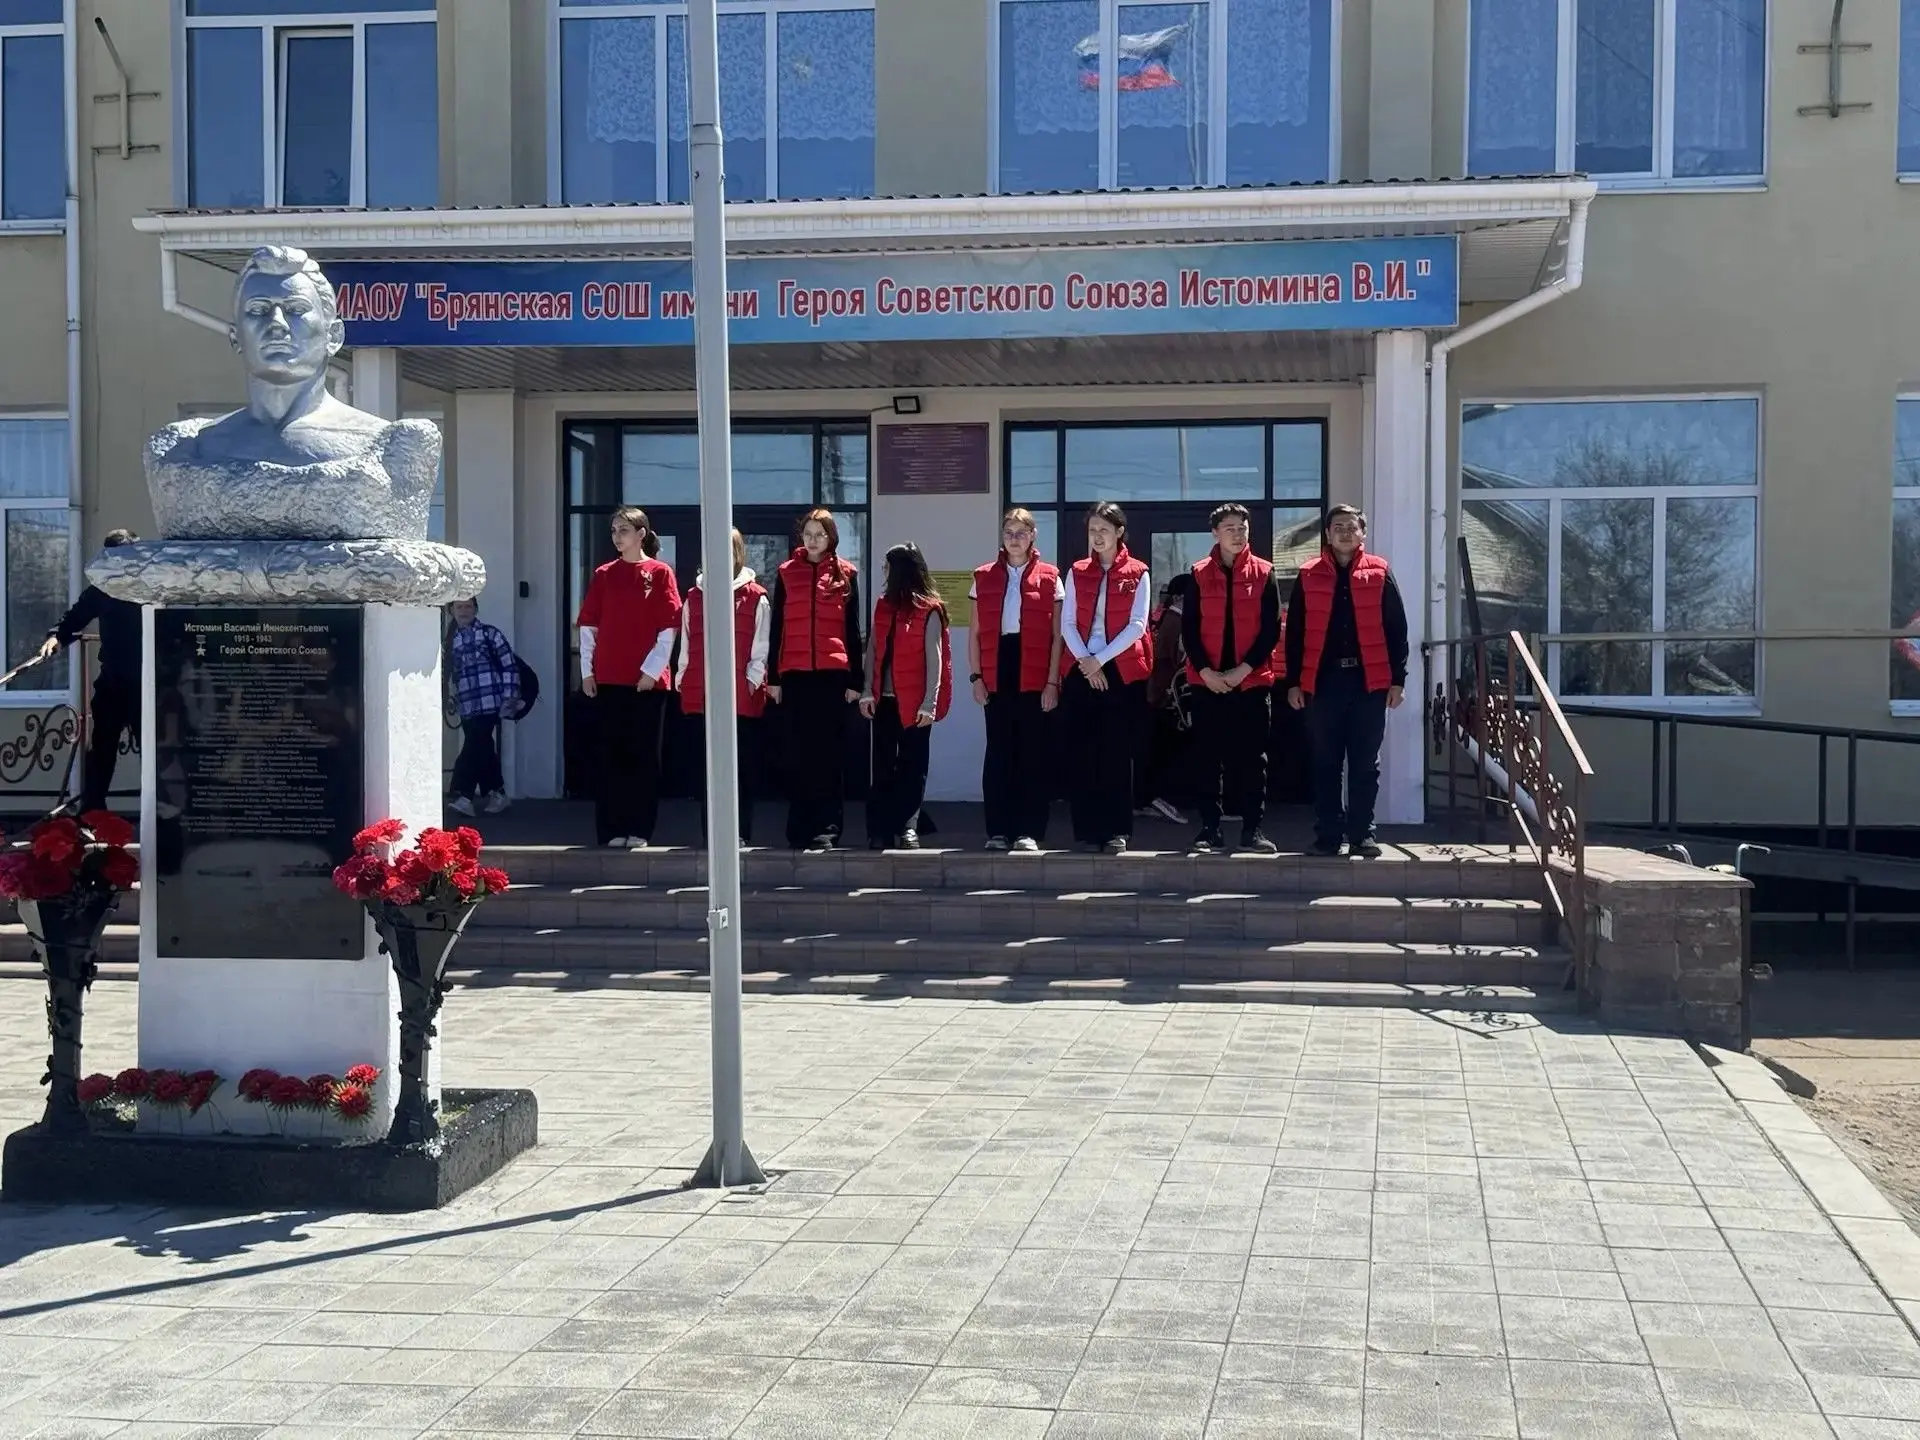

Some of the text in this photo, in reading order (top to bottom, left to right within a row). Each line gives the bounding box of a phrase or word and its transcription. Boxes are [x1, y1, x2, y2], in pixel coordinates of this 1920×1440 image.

[415, 281, 572, 330] "Брянская
[583, 281, 651, 320] СОШ
[660, 289, 760, 320] имни
[777, 279, 866, 327] Героя
[874, 277, 1055, 316] Советского
[1066, 272, 1169, 311] Союза
[1179, 267, 1341, 308] Истомина
[1351, 258, 1432, 303] В.И."
[184, 622, 222, 632] Истомин
[223, 622, 261, 633] Василий
[219, 645, 246, 657] Герой
[247, 645, 297, 656] Советского
